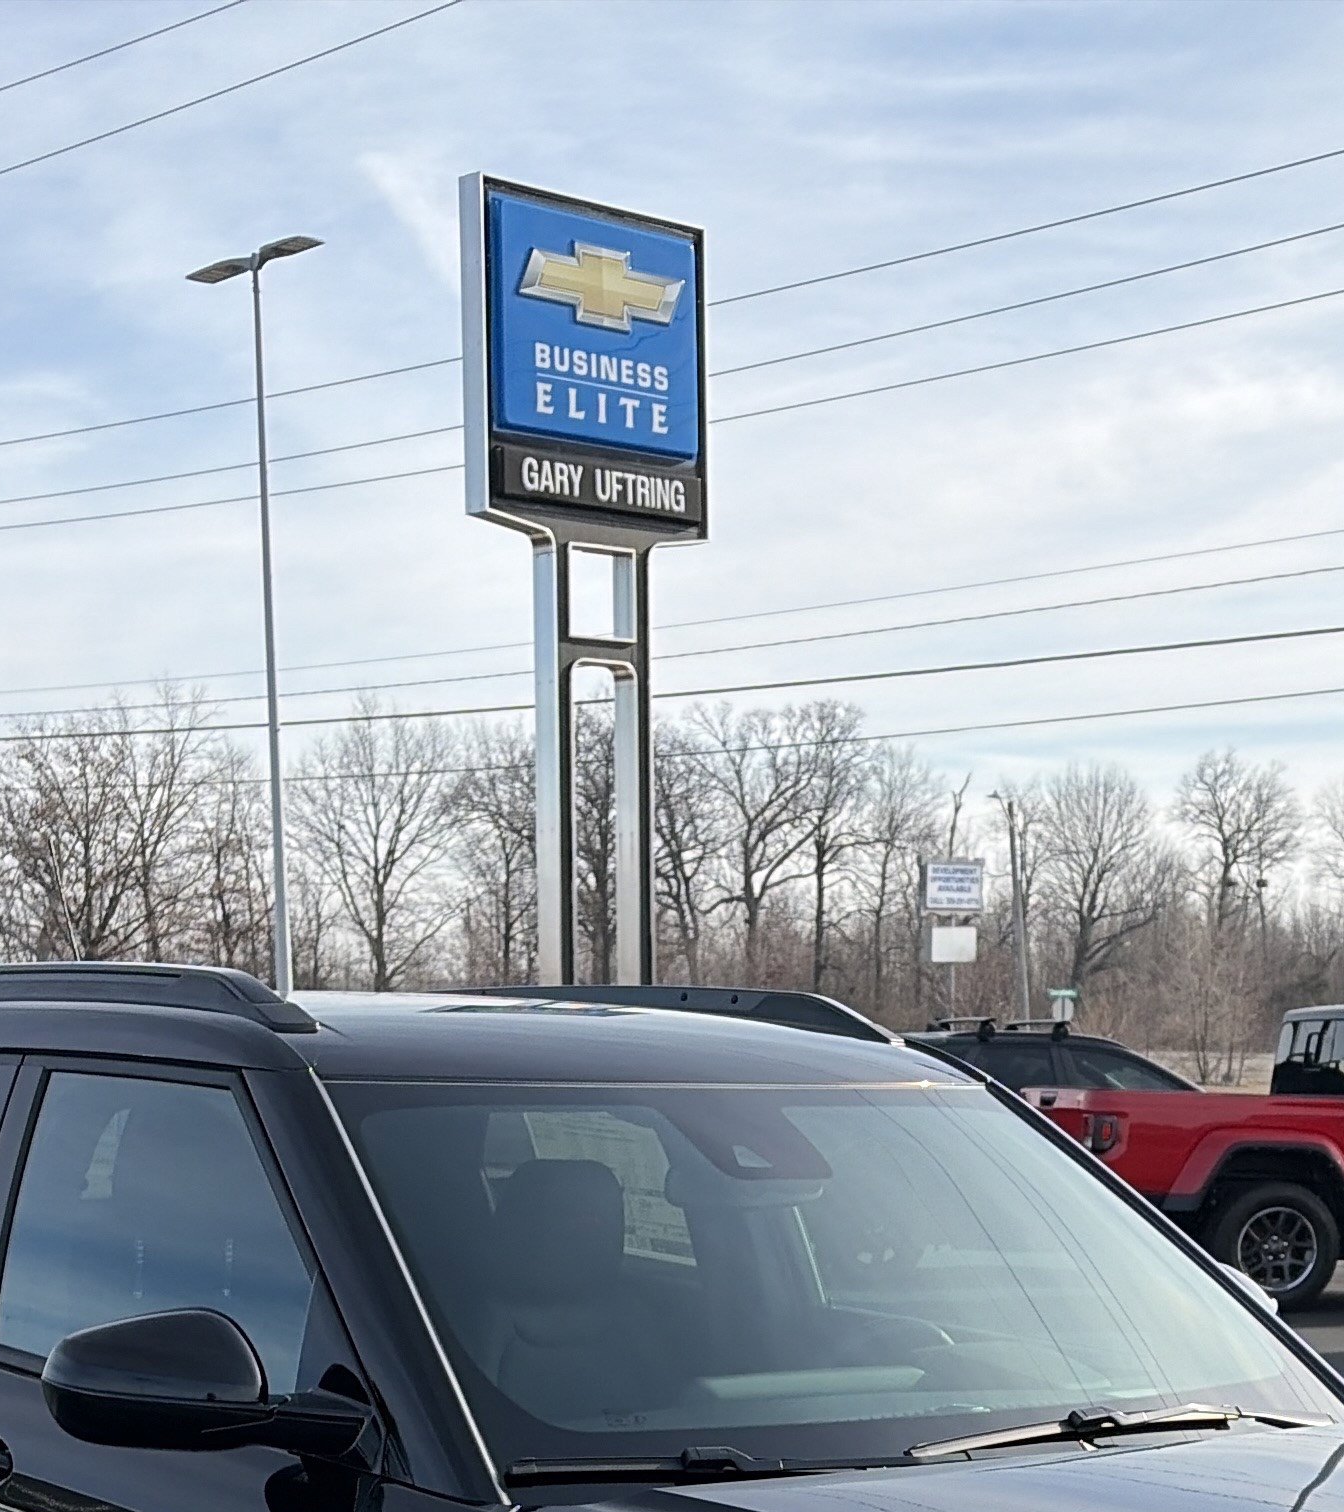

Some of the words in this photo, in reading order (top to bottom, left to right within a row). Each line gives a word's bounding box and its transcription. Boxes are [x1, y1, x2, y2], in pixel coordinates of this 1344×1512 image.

[534, 342, 669, 392] BUSINESS
[536, 382, 669, 435] ELITE
[521, 456, 584, 498] GARY
[595, 468, 686, 514] UFTRING
